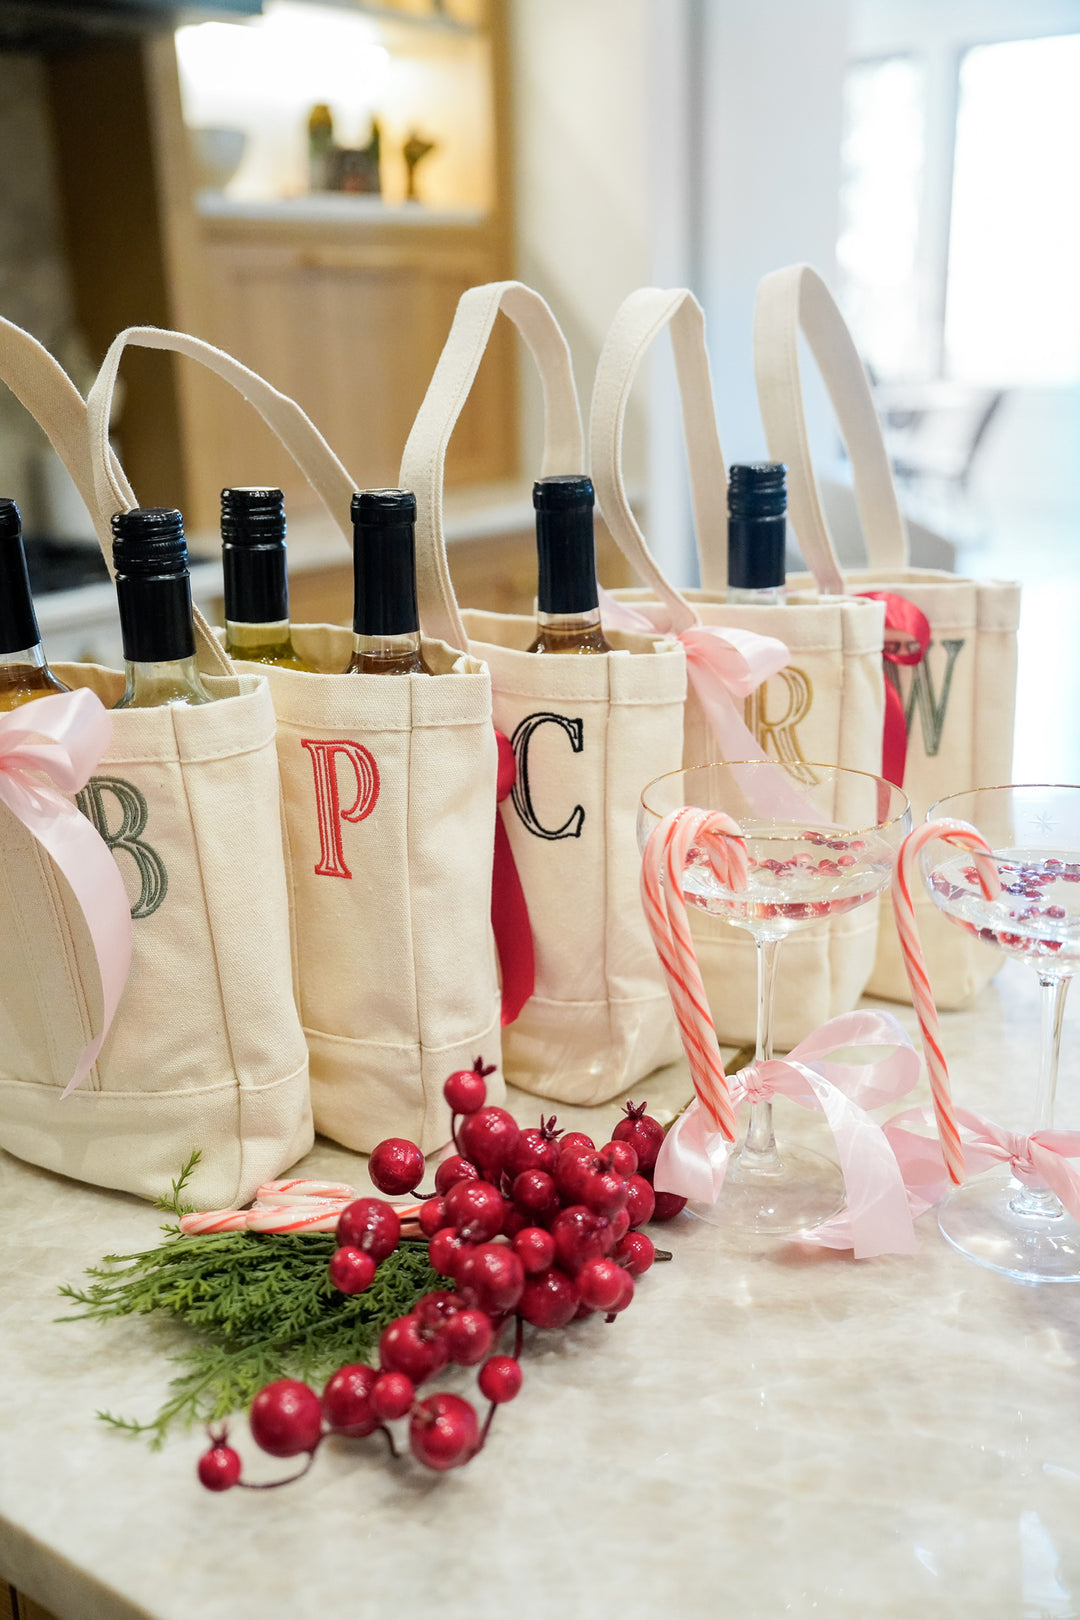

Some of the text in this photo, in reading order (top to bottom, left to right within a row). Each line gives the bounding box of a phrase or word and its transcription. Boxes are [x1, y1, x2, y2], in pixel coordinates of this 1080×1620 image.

[744, 665, 820, 786] R
[882, 638, 966, 757] W
[301, 738, 380, 880] P
[510, 711, 585, 840] C
[75, 775, 168, 919] B
